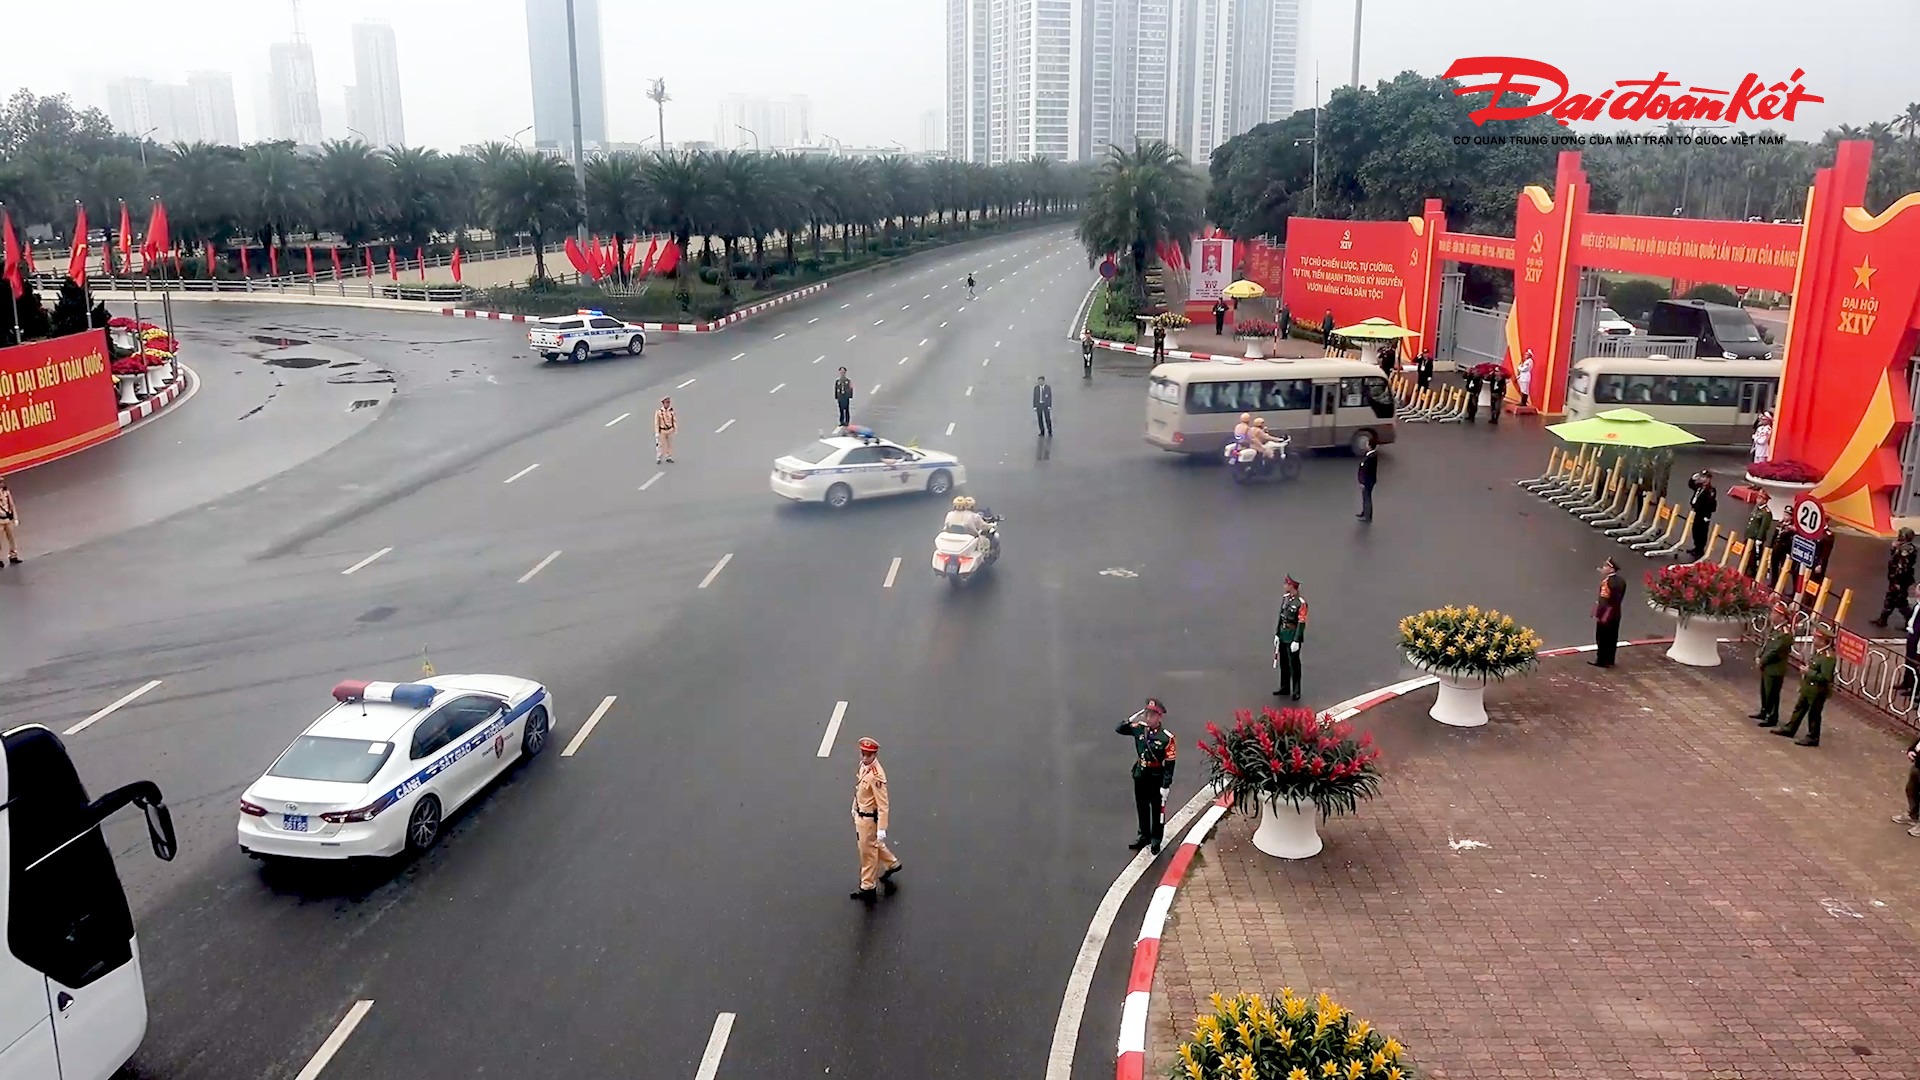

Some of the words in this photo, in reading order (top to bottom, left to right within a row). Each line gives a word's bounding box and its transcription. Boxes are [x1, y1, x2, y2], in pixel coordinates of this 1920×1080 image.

[1344, 273, 1365, 285] TRONG
[1375, 275, 1403, 288] NGUYÊN
[1524, 267, 1543, 283] XIV
[1353, 287, 1368, 298] DÂN
[1842, 296, 1859, 311] ĐẠI
[1860, 296, 1879, 314] HỘI
[1837, 311, 1877, 336] XIV
[16, 369, 37, 396] ĐẠI
[36, 357, 60, 389] BIỂU
[60, 356, 84, 383] TOÀN
[83, 346, 104, 378] QUỐC
[21, 397, 56, 429] ĐẢNG!
[1800, 506, 1818, 530] 20
[395, 776, 422, 799] CẢNH
